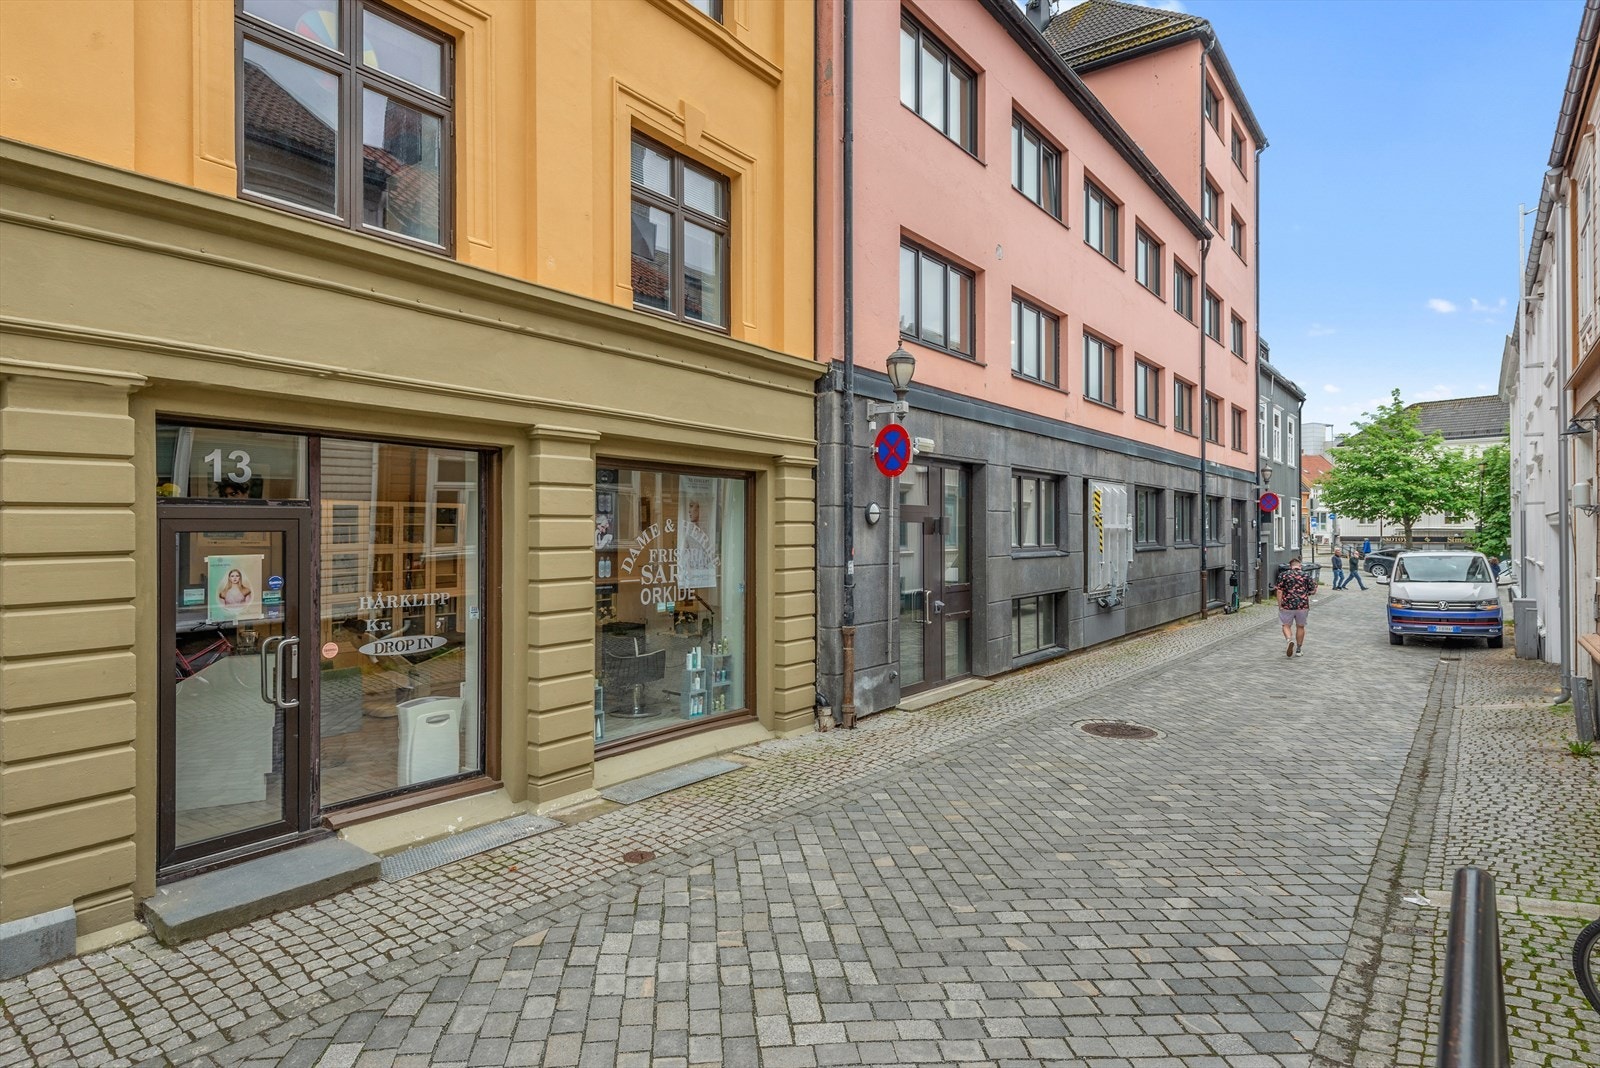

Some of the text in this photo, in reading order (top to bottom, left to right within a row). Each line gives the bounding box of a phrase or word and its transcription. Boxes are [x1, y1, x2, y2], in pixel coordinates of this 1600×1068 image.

[204, 448, 252, 483] 13
[621, 522, 661, 575] DAME
[664, 518, 675, 533] &
[358, 592, 451, 610] HÅRKLIPP
[640, 585, 696, 605] ORKIDE
[365, 618, 392, 632] Kr.
[374, 637, 434, 655] DROP IN
